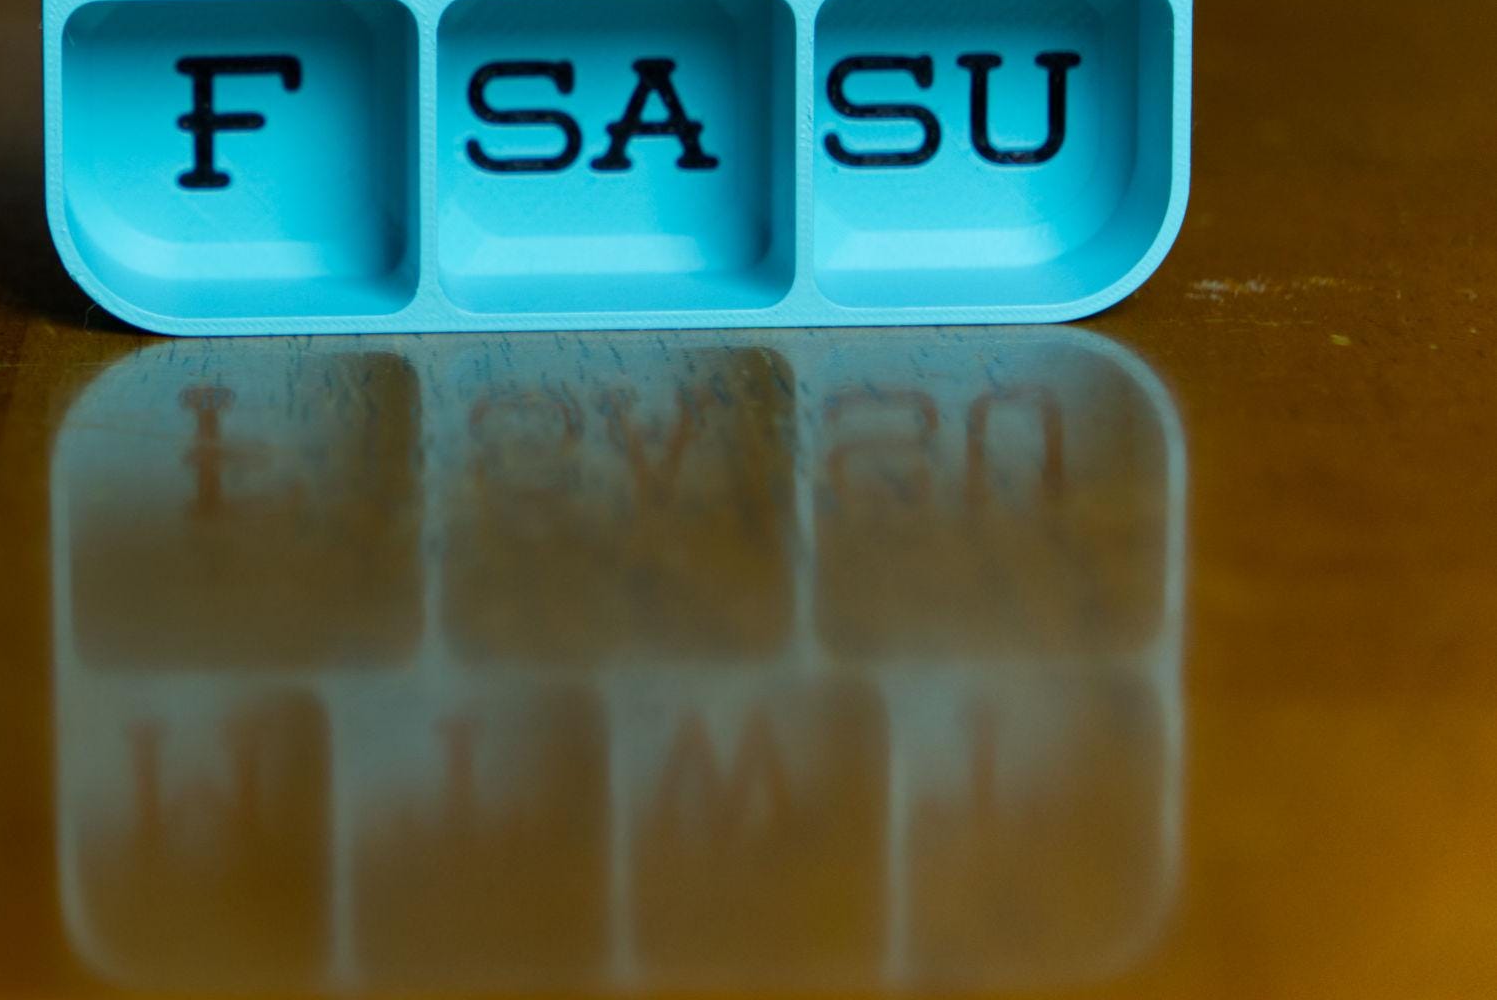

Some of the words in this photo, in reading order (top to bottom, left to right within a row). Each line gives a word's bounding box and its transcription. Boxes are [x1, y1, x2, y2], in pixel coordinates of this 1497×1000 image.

[176, 54, 302, 188] F
[465, 57, 719, 171] SA
[824, 51, 1082, 166] SU
